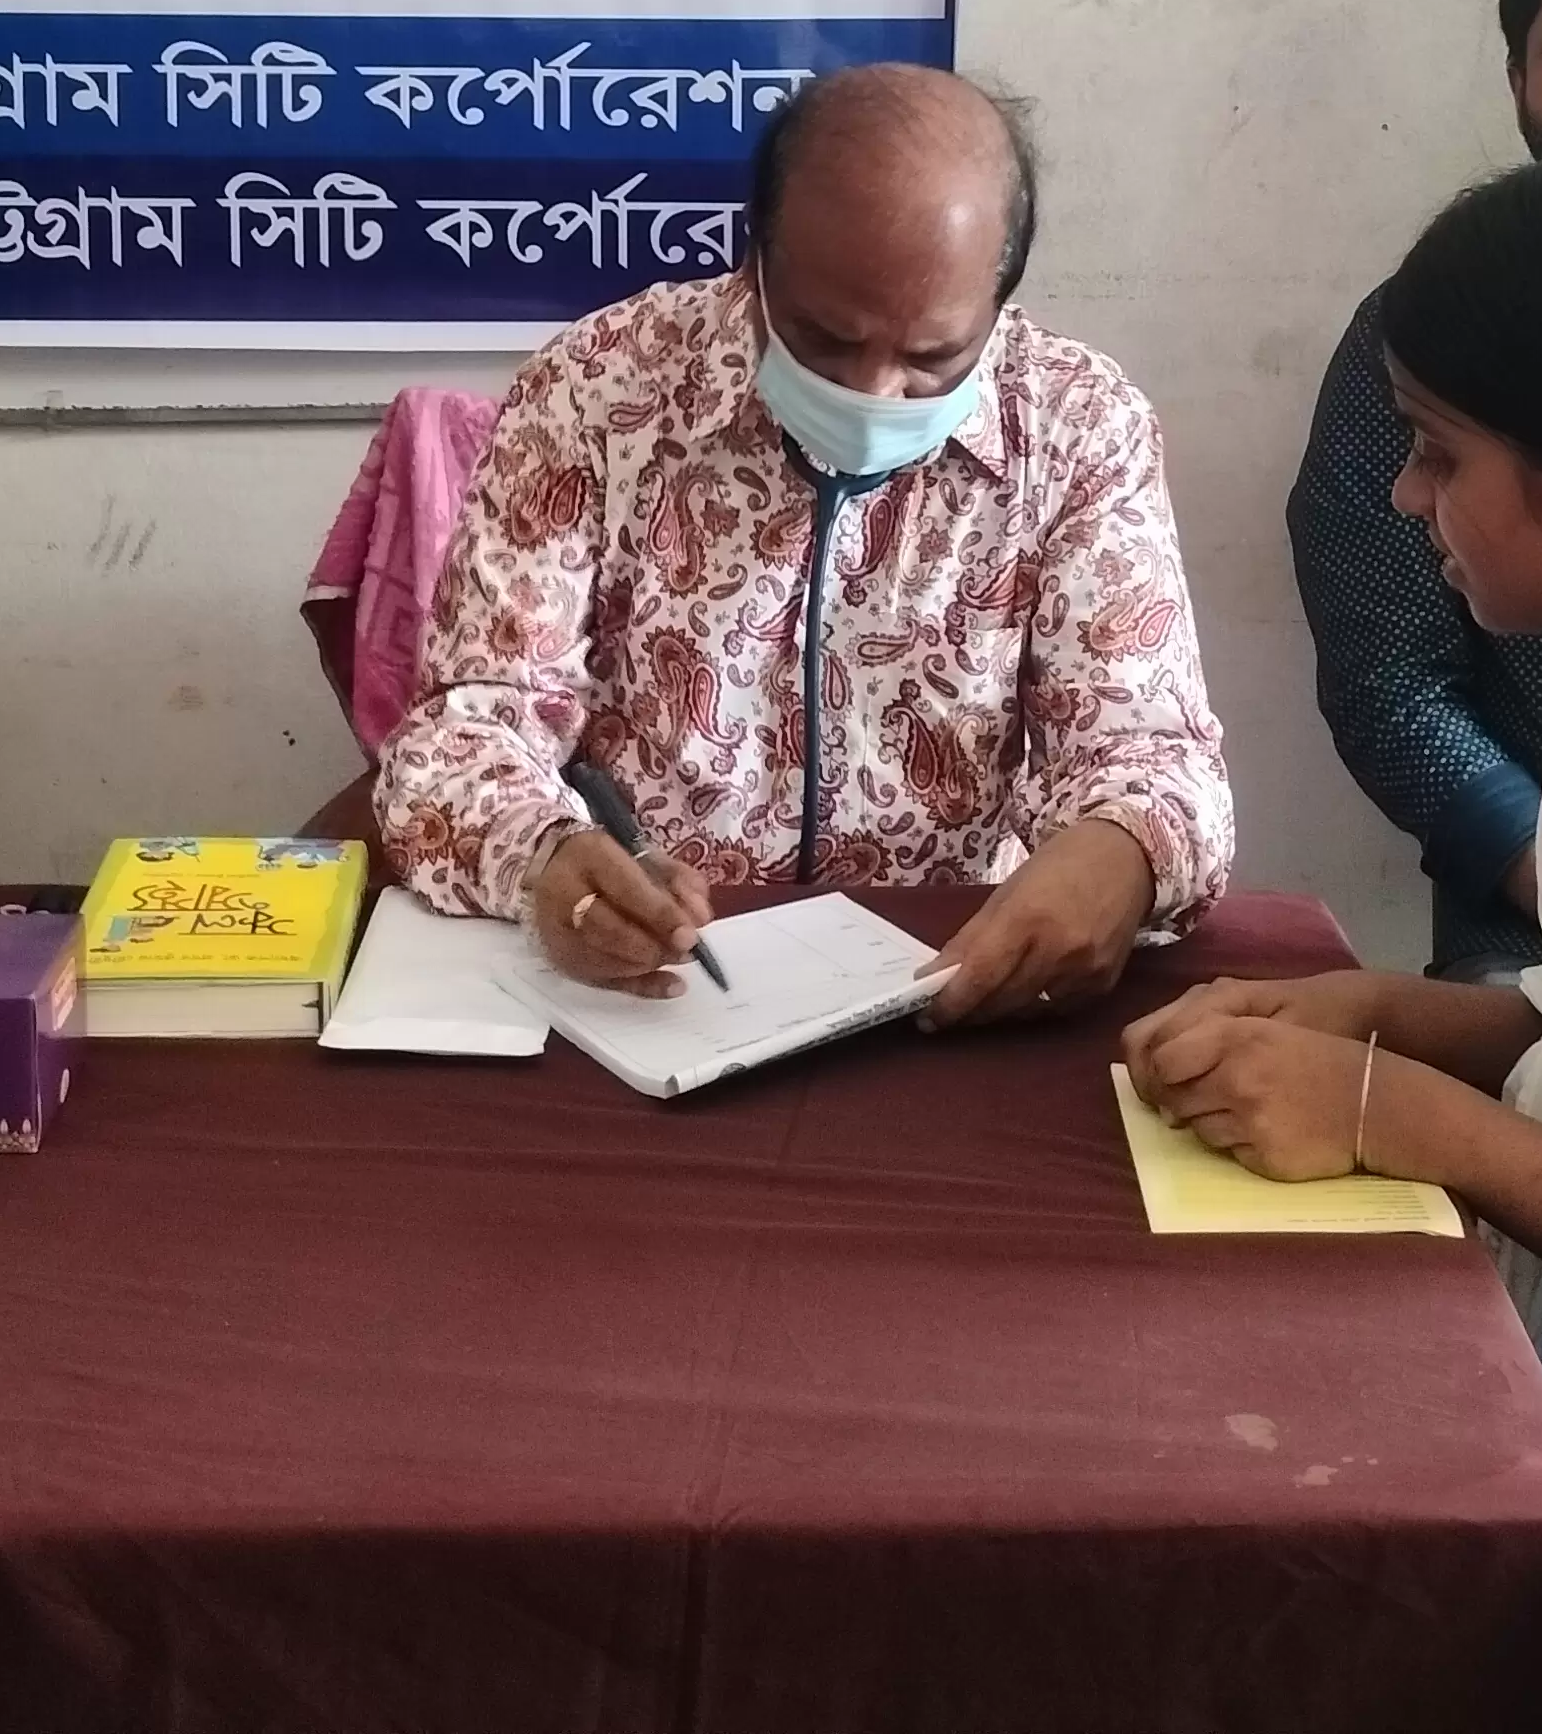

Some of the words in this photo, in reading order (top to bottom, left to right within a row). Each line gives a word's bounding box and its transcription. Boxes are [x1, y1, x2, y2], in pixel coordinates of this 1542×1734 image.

[152, 41, 337, 128] সিটি
[216, 172, 397, 267] সিটি
[416, 173, 745, 268] কর্পোরে
